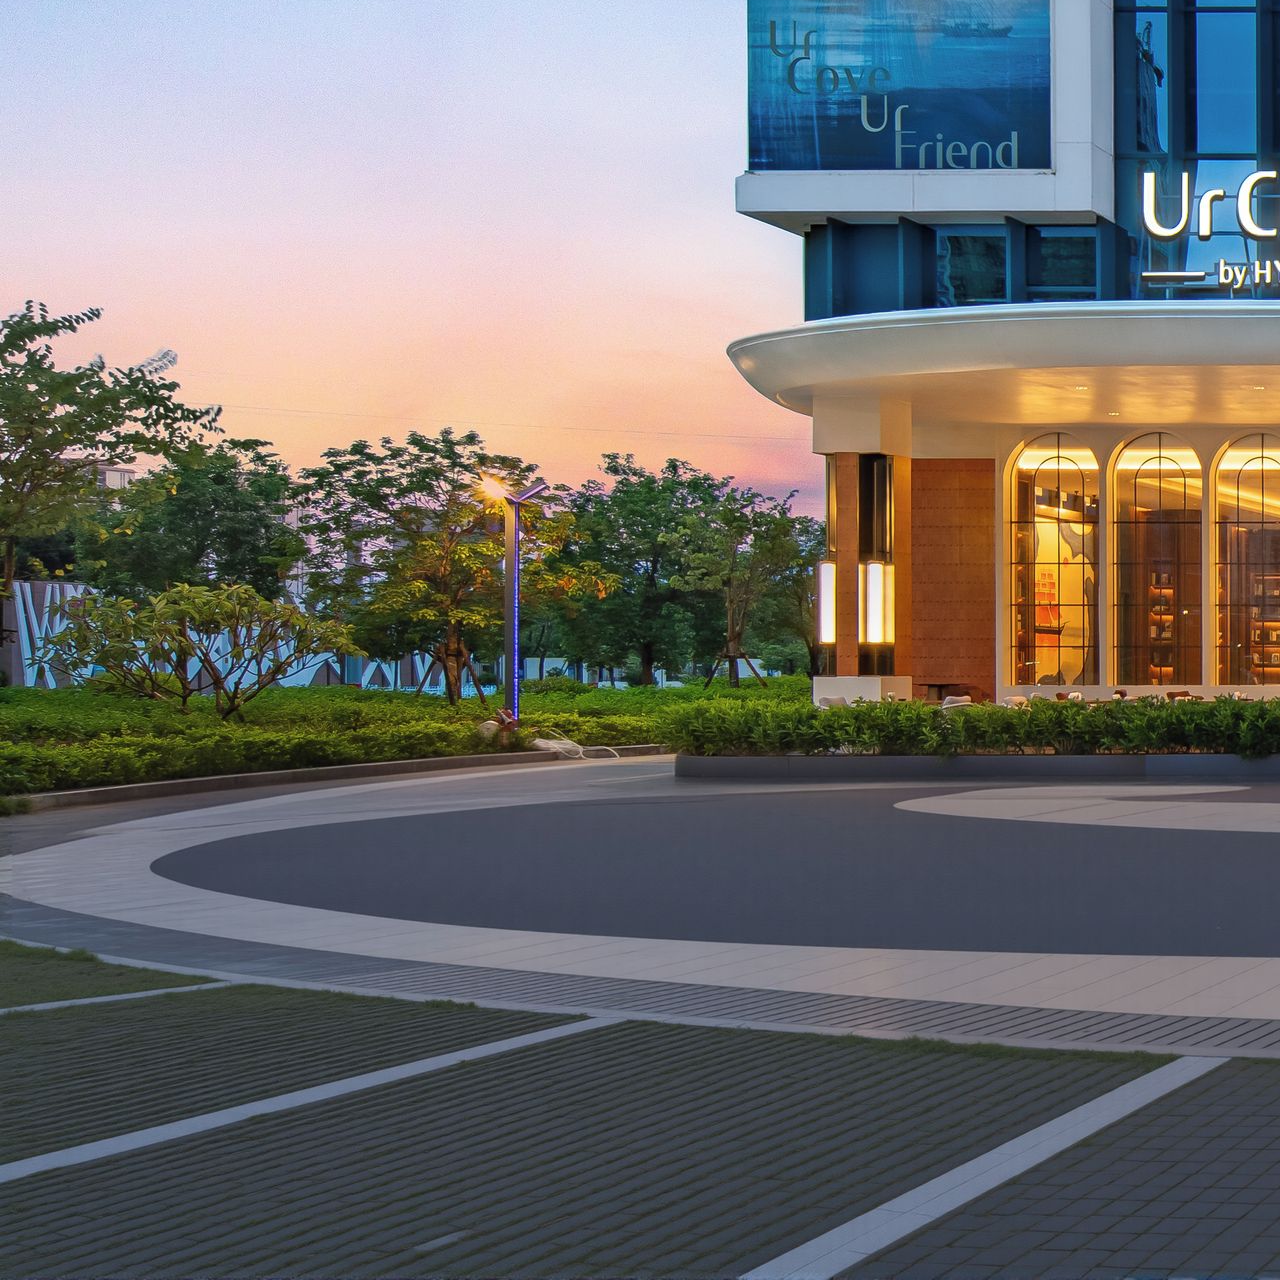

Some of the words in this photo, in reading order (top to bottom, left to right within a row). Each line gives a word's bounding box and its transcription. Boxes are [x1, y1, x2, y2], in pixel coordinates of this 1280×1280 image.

[770, 20, 817, 58] Ur
[788, 57, 891, 95] Cove
[860, 95, 909, 132] Ur
[895, 131, 1018, 169] Friend
[1218, 258, 1246, 288] by
